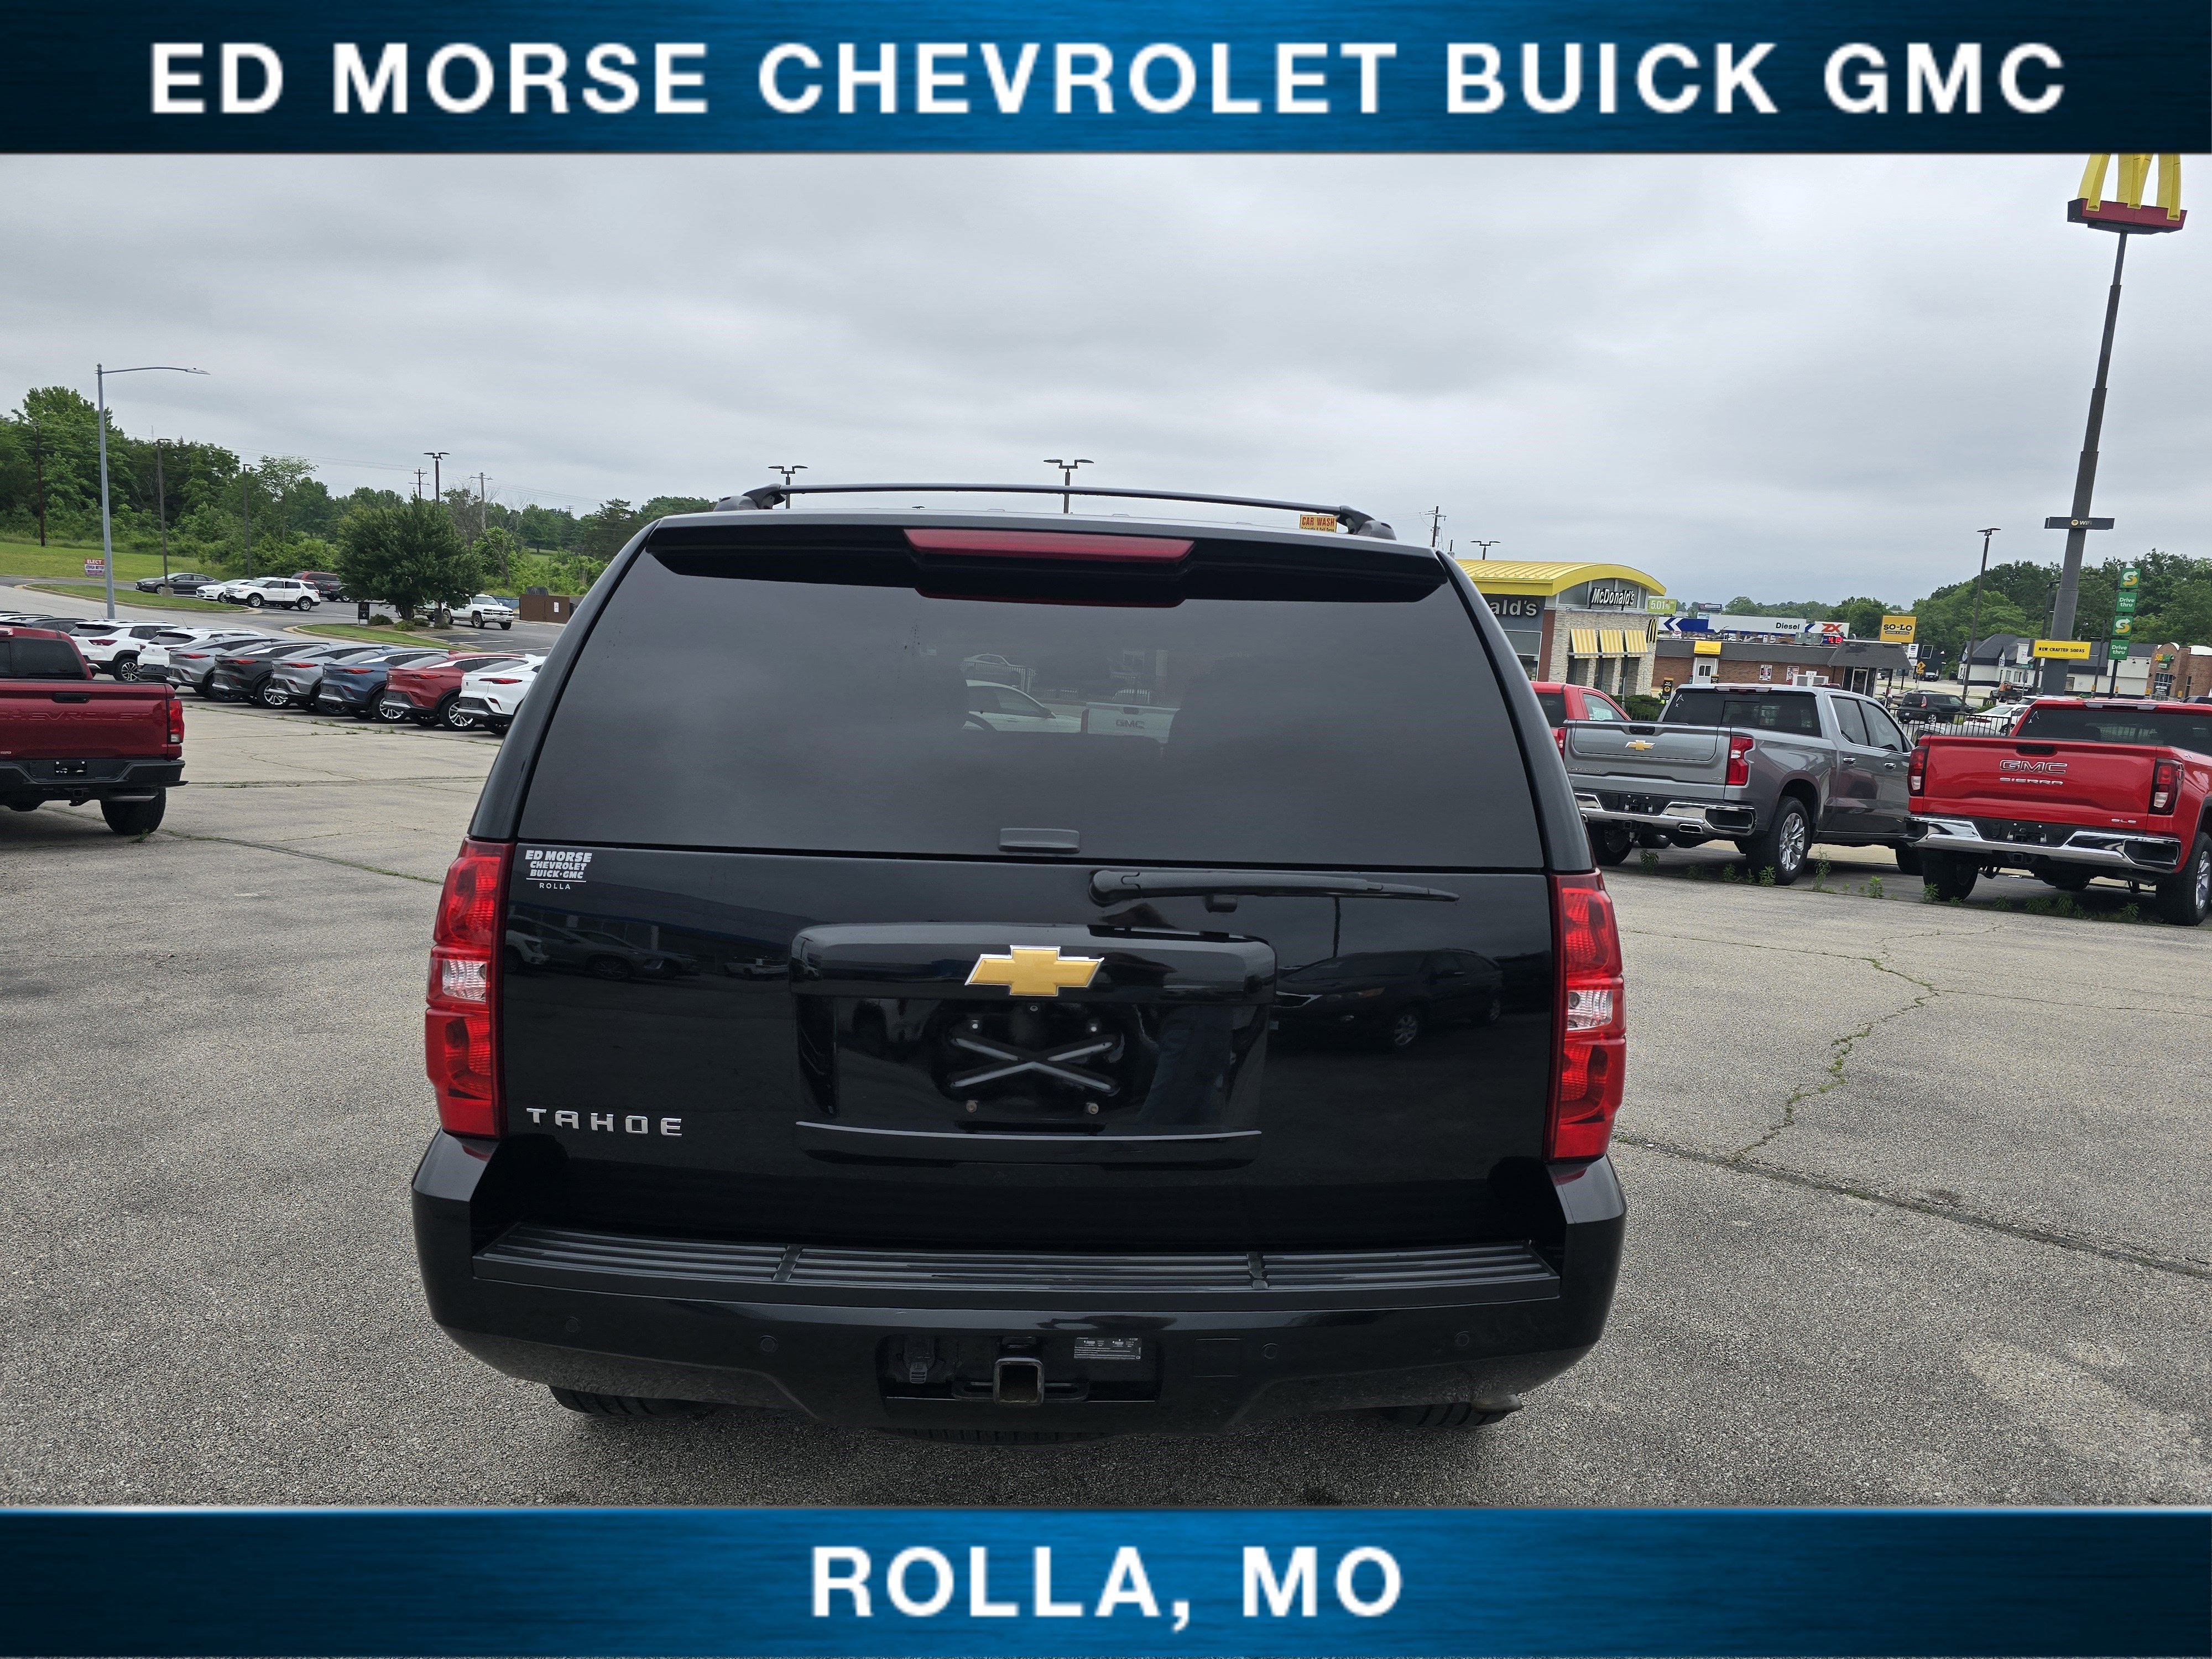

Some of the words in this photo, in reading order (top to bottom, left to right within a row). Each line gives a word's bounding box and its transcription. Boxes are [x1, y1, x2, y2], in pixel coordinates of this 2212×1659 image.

[1302, 517, 1314, 526] CAR
[1317, 517, 1335, 526] WASH
[1591, 587, 1635, 607] McDonald's
[1115, 719, 1145, 729] GMC
[1999, 759, 2068, 774] GMC
[1999, 777, 2063, 785] SIERRA
[525, 849, 544, 860] ED
[544, 851, 593, 863] MORSE
[529, 861, 587, 871] CHEVROLET
[526, 1108, 683, 1136] TAHOE
